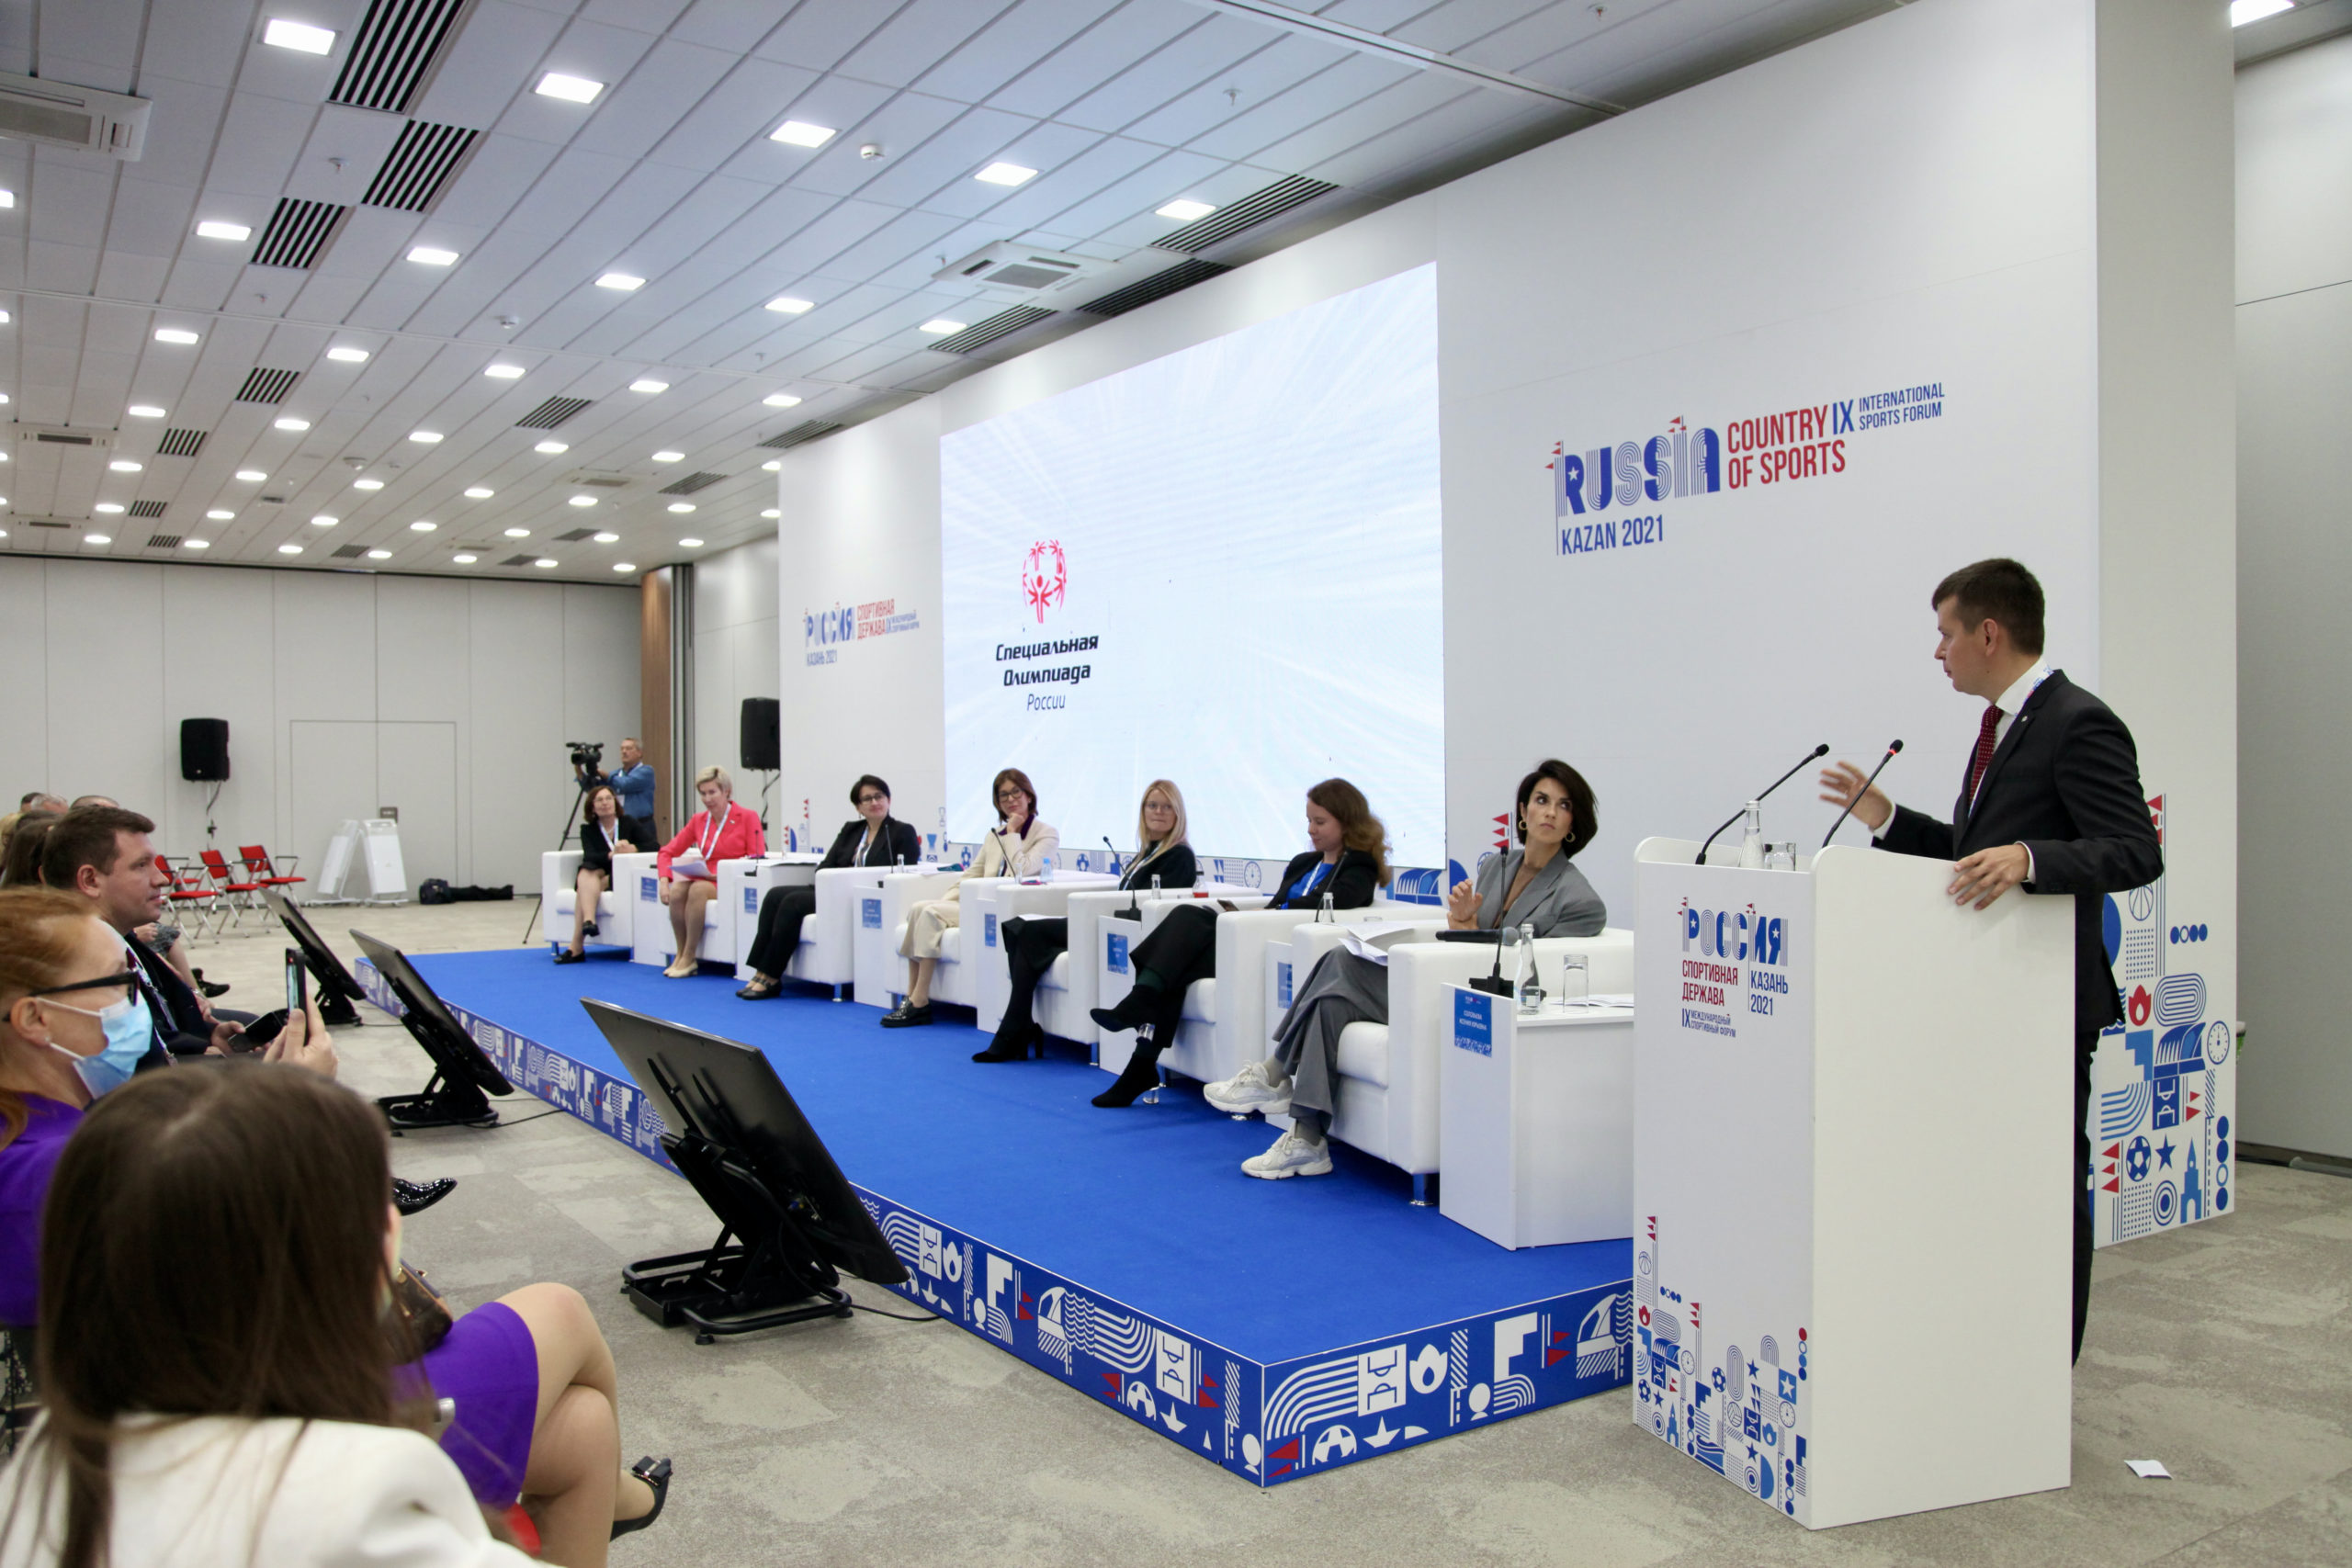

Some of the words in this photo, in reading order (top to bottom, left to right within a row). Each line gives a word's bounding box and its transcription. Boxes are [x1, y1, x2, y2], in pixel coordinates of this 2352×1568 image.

[1859, 382, 1945, 412] INTERNATIONAL
[1727, 405, 1829, 453] COUNTRY
[1832, 400, 1854, 434] IX
[1859, 407, 1900, 431] SPORTS
[1903, 401, 1942, 423] FORUM
[1554, 427, 1721, 517] RUSSIA
[1728, 456, 1754, 490] OF
[1759, 439, 1846, 484] SPORTS
[1562, 521, 1617, 555] KAZAN
[1622, 514, 1664, 547] 2021
[806, 607, 855, 647] РОССИЯ
[996, 635, 1099, 661] Специальная
[1003, 664, 1091, 686] Олимпиада
[1026, 694, 1066, 711] России
[1682, 907, 1788, 966] РОССИЯ
[1682, 960, 1738, 986] СПОРТИВНАЯ
[1750, 970, 1789, 994] КАЗАНЬ
[1682, 982, 1725, 1007] ДЕРЖАВА
[1750, 994, 1773, 1016] 2021
[1690, 1010, 1731, 1025] МЕЖДУНАРОДНЫЙ
[1690, 1020, 1719, 1034] СПОРТИВНЫЙ
[1719, 1026, 1736, 1038] ФОРУМ
